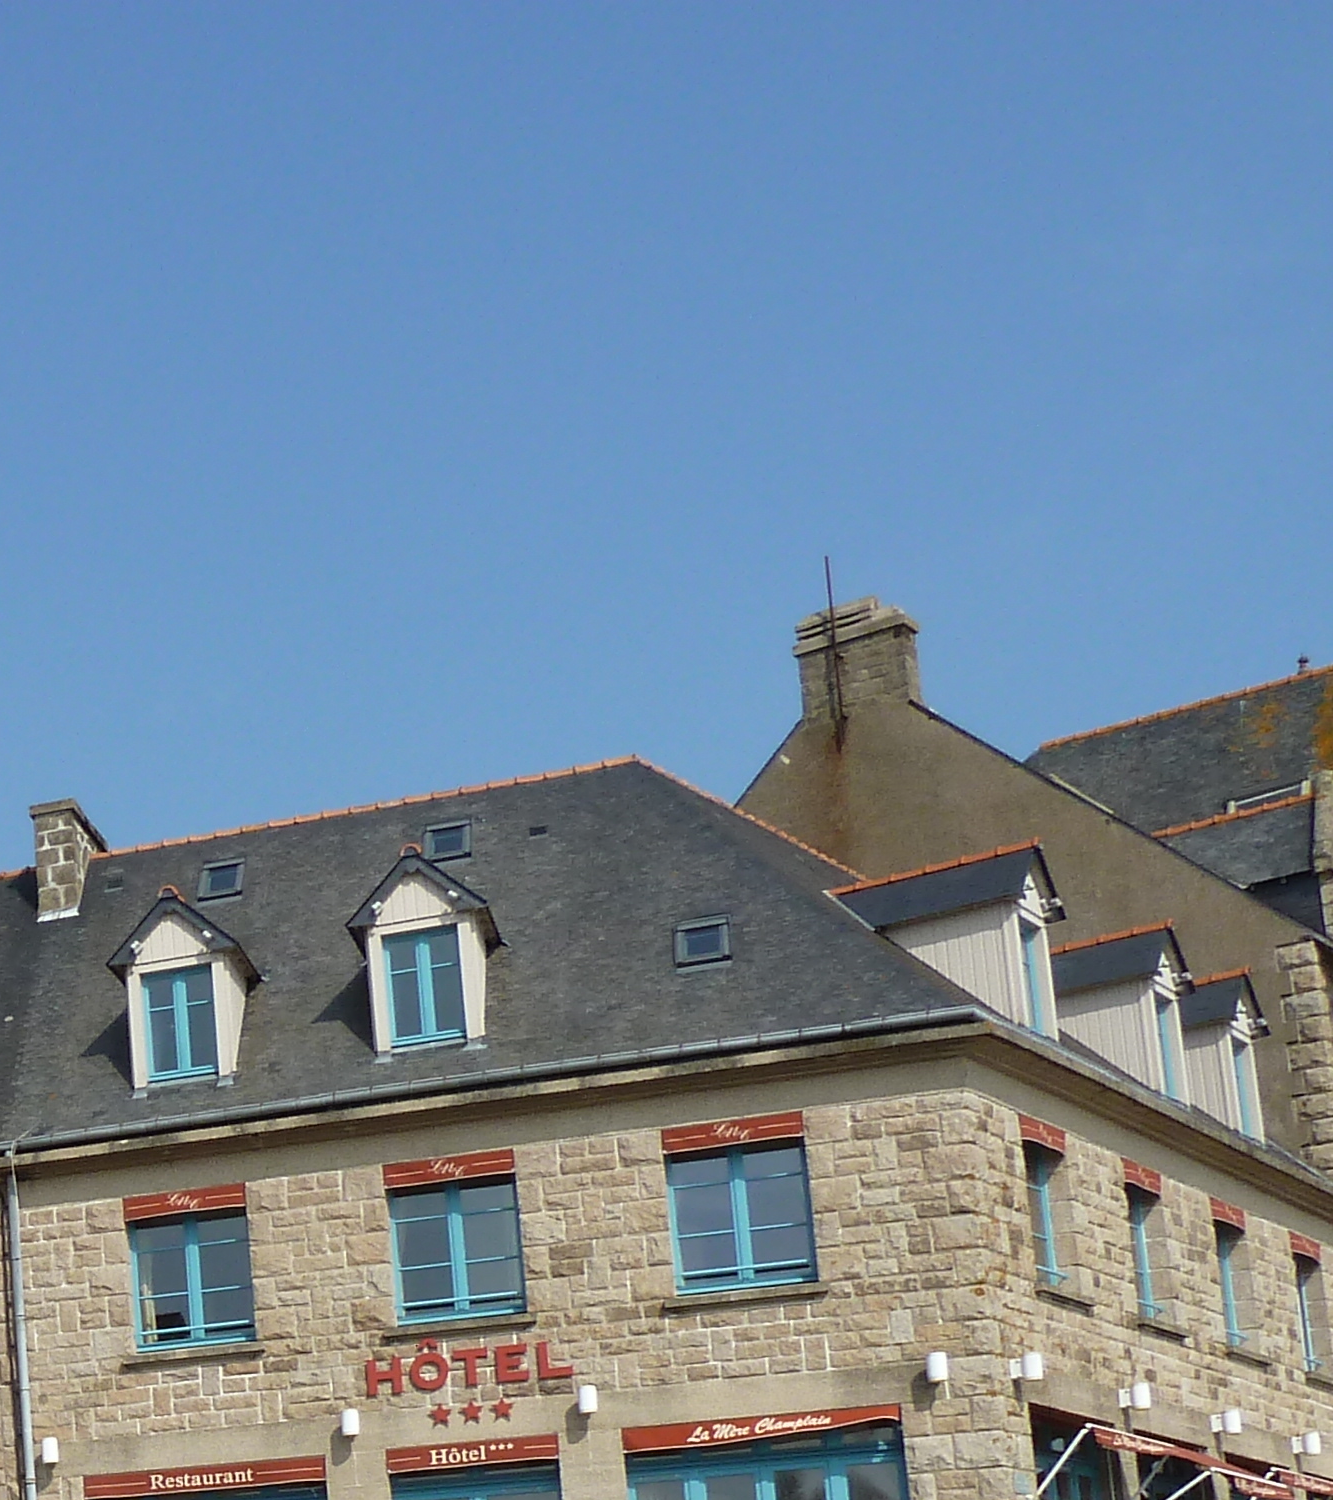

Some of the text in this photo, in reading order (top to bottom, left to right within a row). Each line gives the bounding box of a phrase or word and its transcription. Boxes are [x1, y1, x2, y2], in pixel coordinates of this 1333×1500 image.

[365, 1338, 574, 1398] HÔTEL
[686, 1414, 832, 1443] La Mère Champlain
[429, 1445, 487, 1466] Hôtel
[149, 1467, 254, 1490] Restaurant
